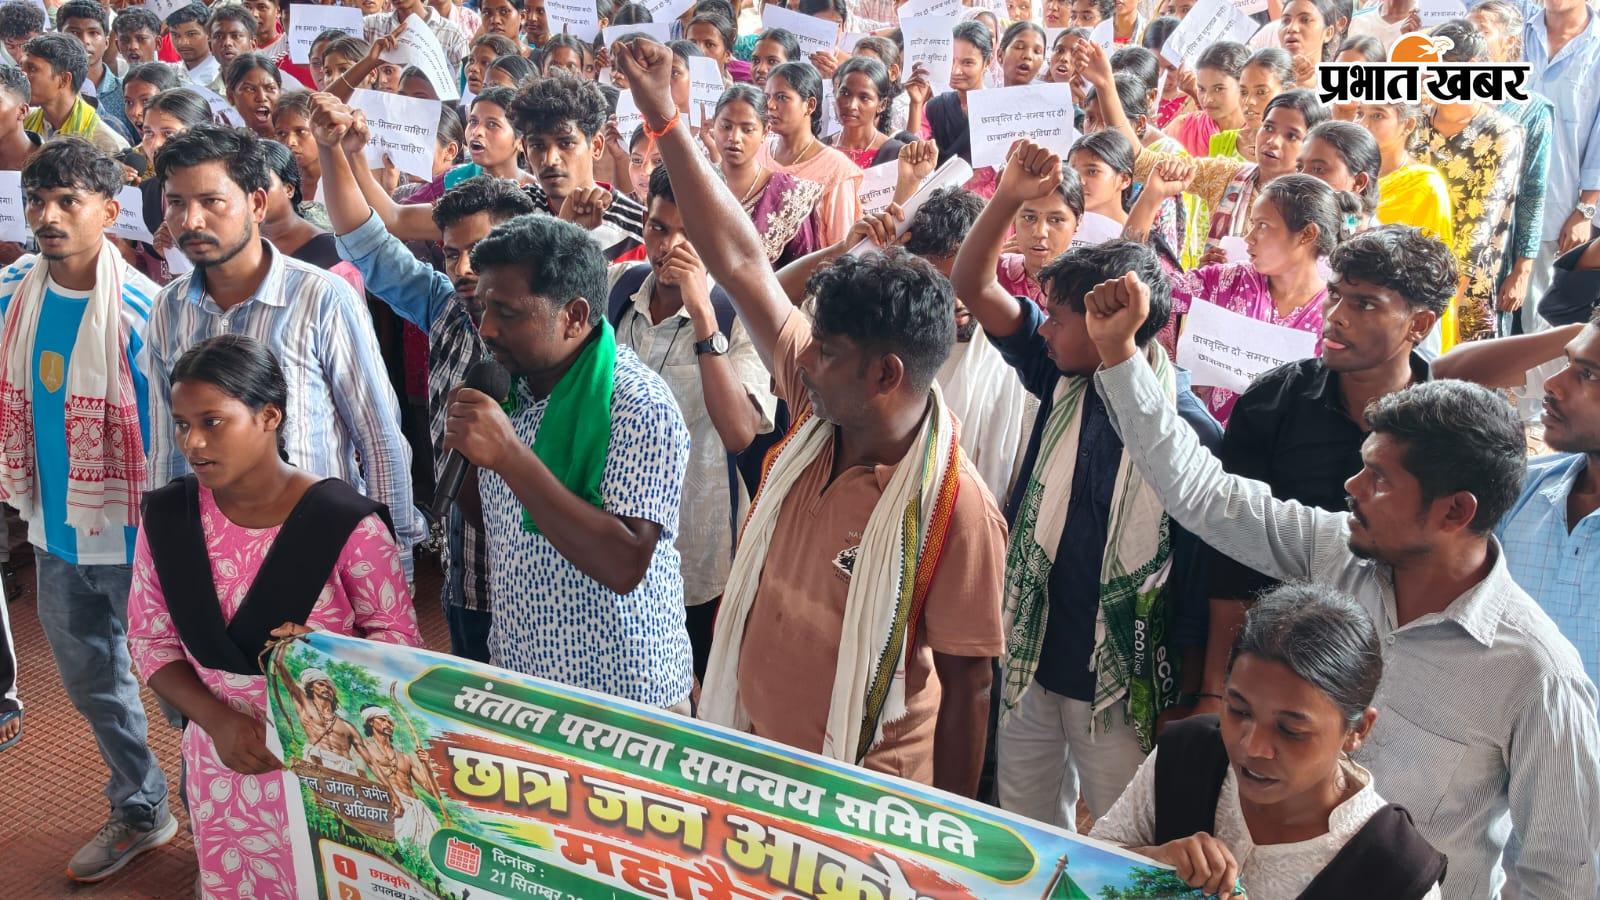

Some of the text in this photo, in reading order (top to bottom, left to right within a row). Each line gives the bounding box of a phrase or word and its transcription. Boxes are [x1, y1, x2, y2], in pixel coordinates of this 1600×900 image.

[1192, 334, 1229, 353] छात्रवृत्ति
[453, 681, 980, 859] संताल परगना समन्वय समिति
[361, 785, 391, 803] जमीन
[446, 746, 572, 813] छात्र
[582, 774, 709, 850] जन
[343, 800, 388, 822] अधिकार
[491, 848, 537, 874] दिनांक
[489, 869, 563, 900] 21 सितम्बर
